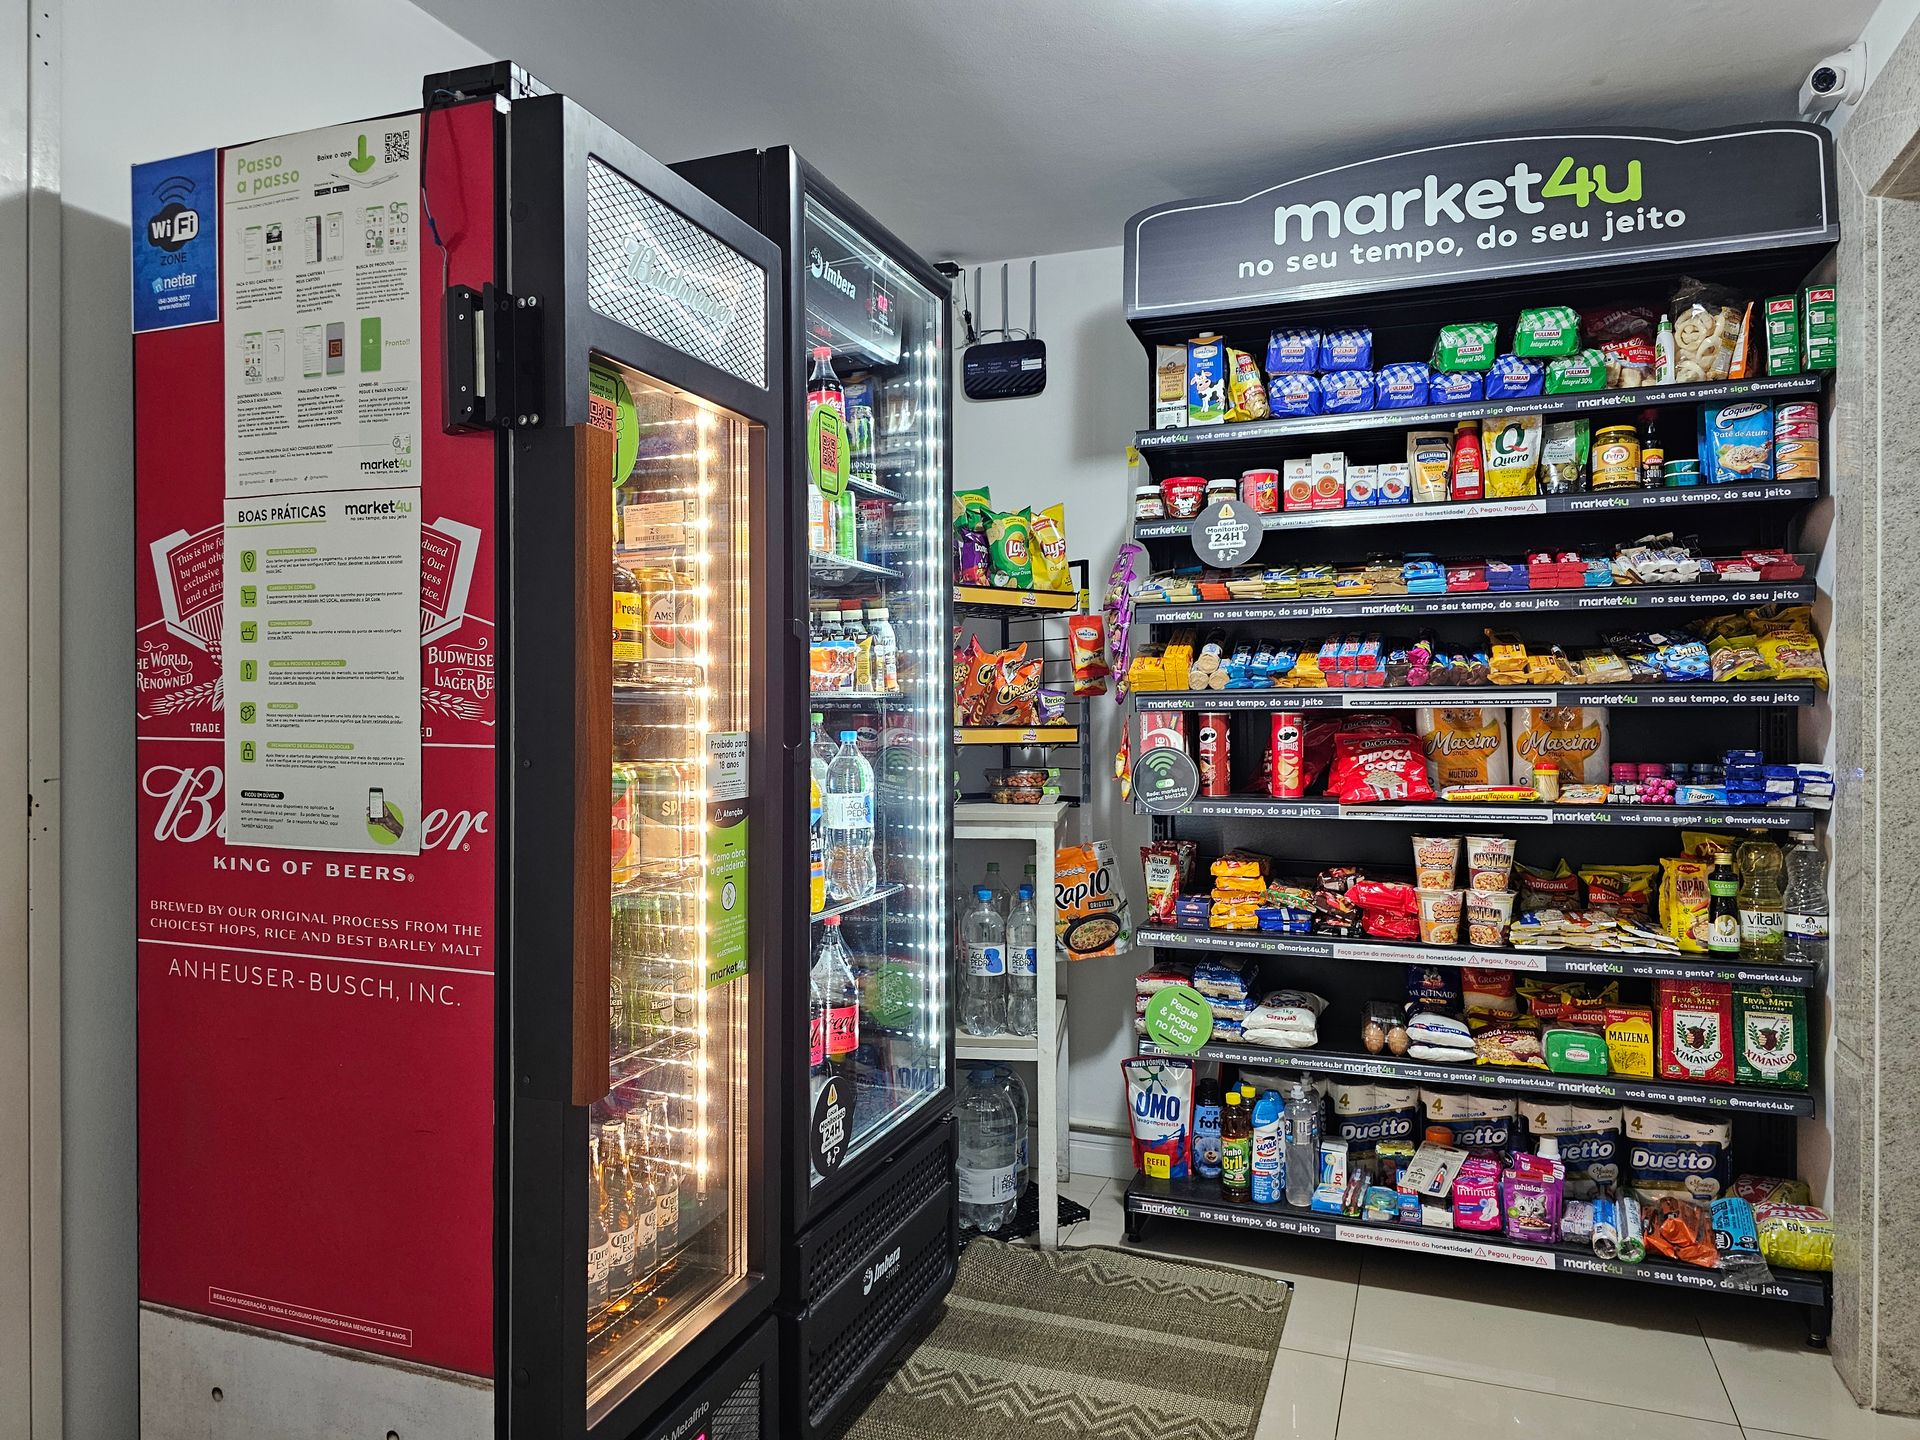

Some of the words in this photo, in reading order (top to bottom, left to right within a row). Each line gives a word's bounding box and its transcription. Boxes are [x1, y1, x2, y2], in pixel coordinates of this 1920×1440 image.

[317, 153, 332, 162] Baixe
[339, 150, 352, 160] app
[237, 155, 282, 175] Passo
[237, 181, 247, 193] a
[253, 169, 300, 195] passo
[1274, 156, 1642, 246] market4u
[152, 215, 195, 239] WiFi
[1239, 259, 1274, 279] no
[1286, 251, 1337, 273] seu
[1350, 237, 1464, 264] tempo,
[1476, 225, 1518, 250] do
[1531, 221, 1589, 244] seu
[1601, 207, 1686, 242] jeito
[160, 253, 187, 266] ZONE
[164, 273, 197, 289] netfar
[823, 261, 856, 300] Imbera
[1458, 346, 1483, 354] PULLMAN
[1646, 392, 1666, 401] você
[1668, 391, 1688, 399] ama
[1697, 386, 1728, 397] gente?
[1730, 385, 1749, 394] siga
[1751, 379, 1816, 391] @market4u.br
[1578, 395, 1636, 408] market4u
[1458, 408, 1485, 418] gente?
[1487, 404, 1503, 414] siga
[1505, 402, 1564, 413] @market4u.br
[1722, 403, 1763, 417] Coqueiro
[1141, 433, 1189, 445] market4u
[1196, 433, 1213, 441] você
[1238, 427, 1262, 437] gente?
[1492, 453, 1530, 468] Quero
[1571, 498, 1629, 509] market4u
[1643, 496, 1658, 504] no
[1659, 495, 1680, 504] seu
[1682, 492, 1722, 506] tempo,
[1724, 491, 1739, 500] do
[1742, 490, 1763, 500] seu
[1764, 488, 1791, 500] jeito
[238, 509, 268, 523] BOAS
[271, 503, 326, 521] PRÁTICAS
[1424, 509, 1466, 517] honestidade!
[1480, 505, 1503, 513] Pegou,
[1504, 505, 1526, 513] Pagou
[1207, 525, 1249, 533] Monitorado
[1215, 532, 1240, 542] 24H
[1579, 595, 1637, 607] market4u
[1244, 609, 1276, 619] tempo,
[1279, 608, 1290, 616] do
[1311, 606, 1333, 616] jeito
[428, 646, 494, 667] BUDWEISE
[137, 672, 193, 693] RENOWNED
[998, 676, 1039, 704] Cheetos
[190, 723, 220, 733] TRADE
[711, 740, 734, 749] Proibido
[735, 739, 748, 748] para
[1427, 731, 1499, 755] Maxim
[1521, 731, 1597, 756] Maxim
[714, 751, 739, 760] menores
[740, 749, 745, 757] de
[1358, 750, 1413, 764] PIPOCA
[720, 761, 725, 769] 18
[726, 760, 740, 769] anos
[1365, 762, 1406, 773] DOGE
[723, 808, 744, 818] Atenção
[1553, 812, 1611, 822] market4u
[1621, 815, 1641, 823] você
[713, 852, 730, 862] Como
[732, 848, 745, 858] abro
[213, 856, 270, 873] KING
[282, 860, 313, 875] OF
[1055, 868, 1110, 910] Rap10
[1595, 876, 1621, 890] Yoki
[1676, 878, 1705, 893] SOPÃO
[1090, 900, 1113, 909] ORIGINAL
[150, 900, 204, 914] BREWED
[208, 905, 224, 915] BY
[228, 906, 257, 918] OUR
[261, 909, 328, 925] ORIGINAL
[333, 915, 399, 930] PROCESS
[405, 920, 448, 934] FROM
[453, 924, 482, 937] THE
[150, 918, 216, 933] CHOICEST
[219, 923, 260, 939] HOPS,
[265, 928, 296, 940] RICE
[301, 931, 331, 944] AND
[337, 934, 373, 947] BEST
[379, 938, 436, 952] BARLEY
[442, 943, 483, 957] MALT
[1712, 936, 1739, 944] GALLO
[1349, 950, 1368, 959] parte
[1380, 952, 1415, 961] movimento
[1426, 954, 1467, 964] honestidade!
[710, 960, 747, 982] market4u
[1565, 961, 1623, 973] market4u
[168, 958, 400, 1002] ANHEUSER-BUSCH,
[410, 982, 461, 1007] INC.
[1738, 972, 1803, 983] @market4u.br
[1170, 998, 1199, 1020] Pegue
[1160, 1007, 1168, 1016] &
[1168, 1012, 1198, 1034] pague
[1155, 1019, 1168, 1030] no
[1170, 1027, 1193, 1045] local
[1608, 1030, 1650, 1044] MAIZENA
[1674, 1048, 1723, 1065] XIMANGO
[1746, 1049, 1796, 1066] XIMANGO
[1136, 1092, 1181, 1121] OMO
[1339, 1093, 1350, 1107] 4
[1730, 1098, 1795, 1111] @market4u.br
[1342, 1119, 1411, 1140] Duetto
[1631, 1116, 1643, 1131] 4
[825, 1123, 841, 1141] 24H
[1146, 1158, 1167, 1167] REFIL
[1223, 1156, 1242, 1170] Bril
[1632, 1150, 1714, 1171] Duetto
[1514, 1184, 1544, 1193] whiskas
[1200, 1211, 1211, 1220] no
[1213, 1212, 1230, 1222] seu
[1232, 1214, 1263, 1227] tempo,
[1265, 1219, 1278, 1228] do
[1279, 1221, 1297, 1231] seu
[1298, 1222, 1321, 1234] jeito
[873, 1246, 901, 1284] Imbera
[1563, 1258, 1623, 1275] market4u
[213, 1292, 226, 1301] BEBA
[226, 1295, 237, 1303] COM
[268, 1304, 284, 1314] VENDA
[288, 1309, 313, 1320] CONSUMO
[313, 1314, 339, 1326] PROIBIDOS
[339, 1320, 352, 1329] PARA
[353, 1323, 377, 1335] MENORES
[386, 1329, 391, 1337] 18
[392, 1331, 408, 1341] ANOS.
[672, 1401, 710, 1440] Metalfrio
